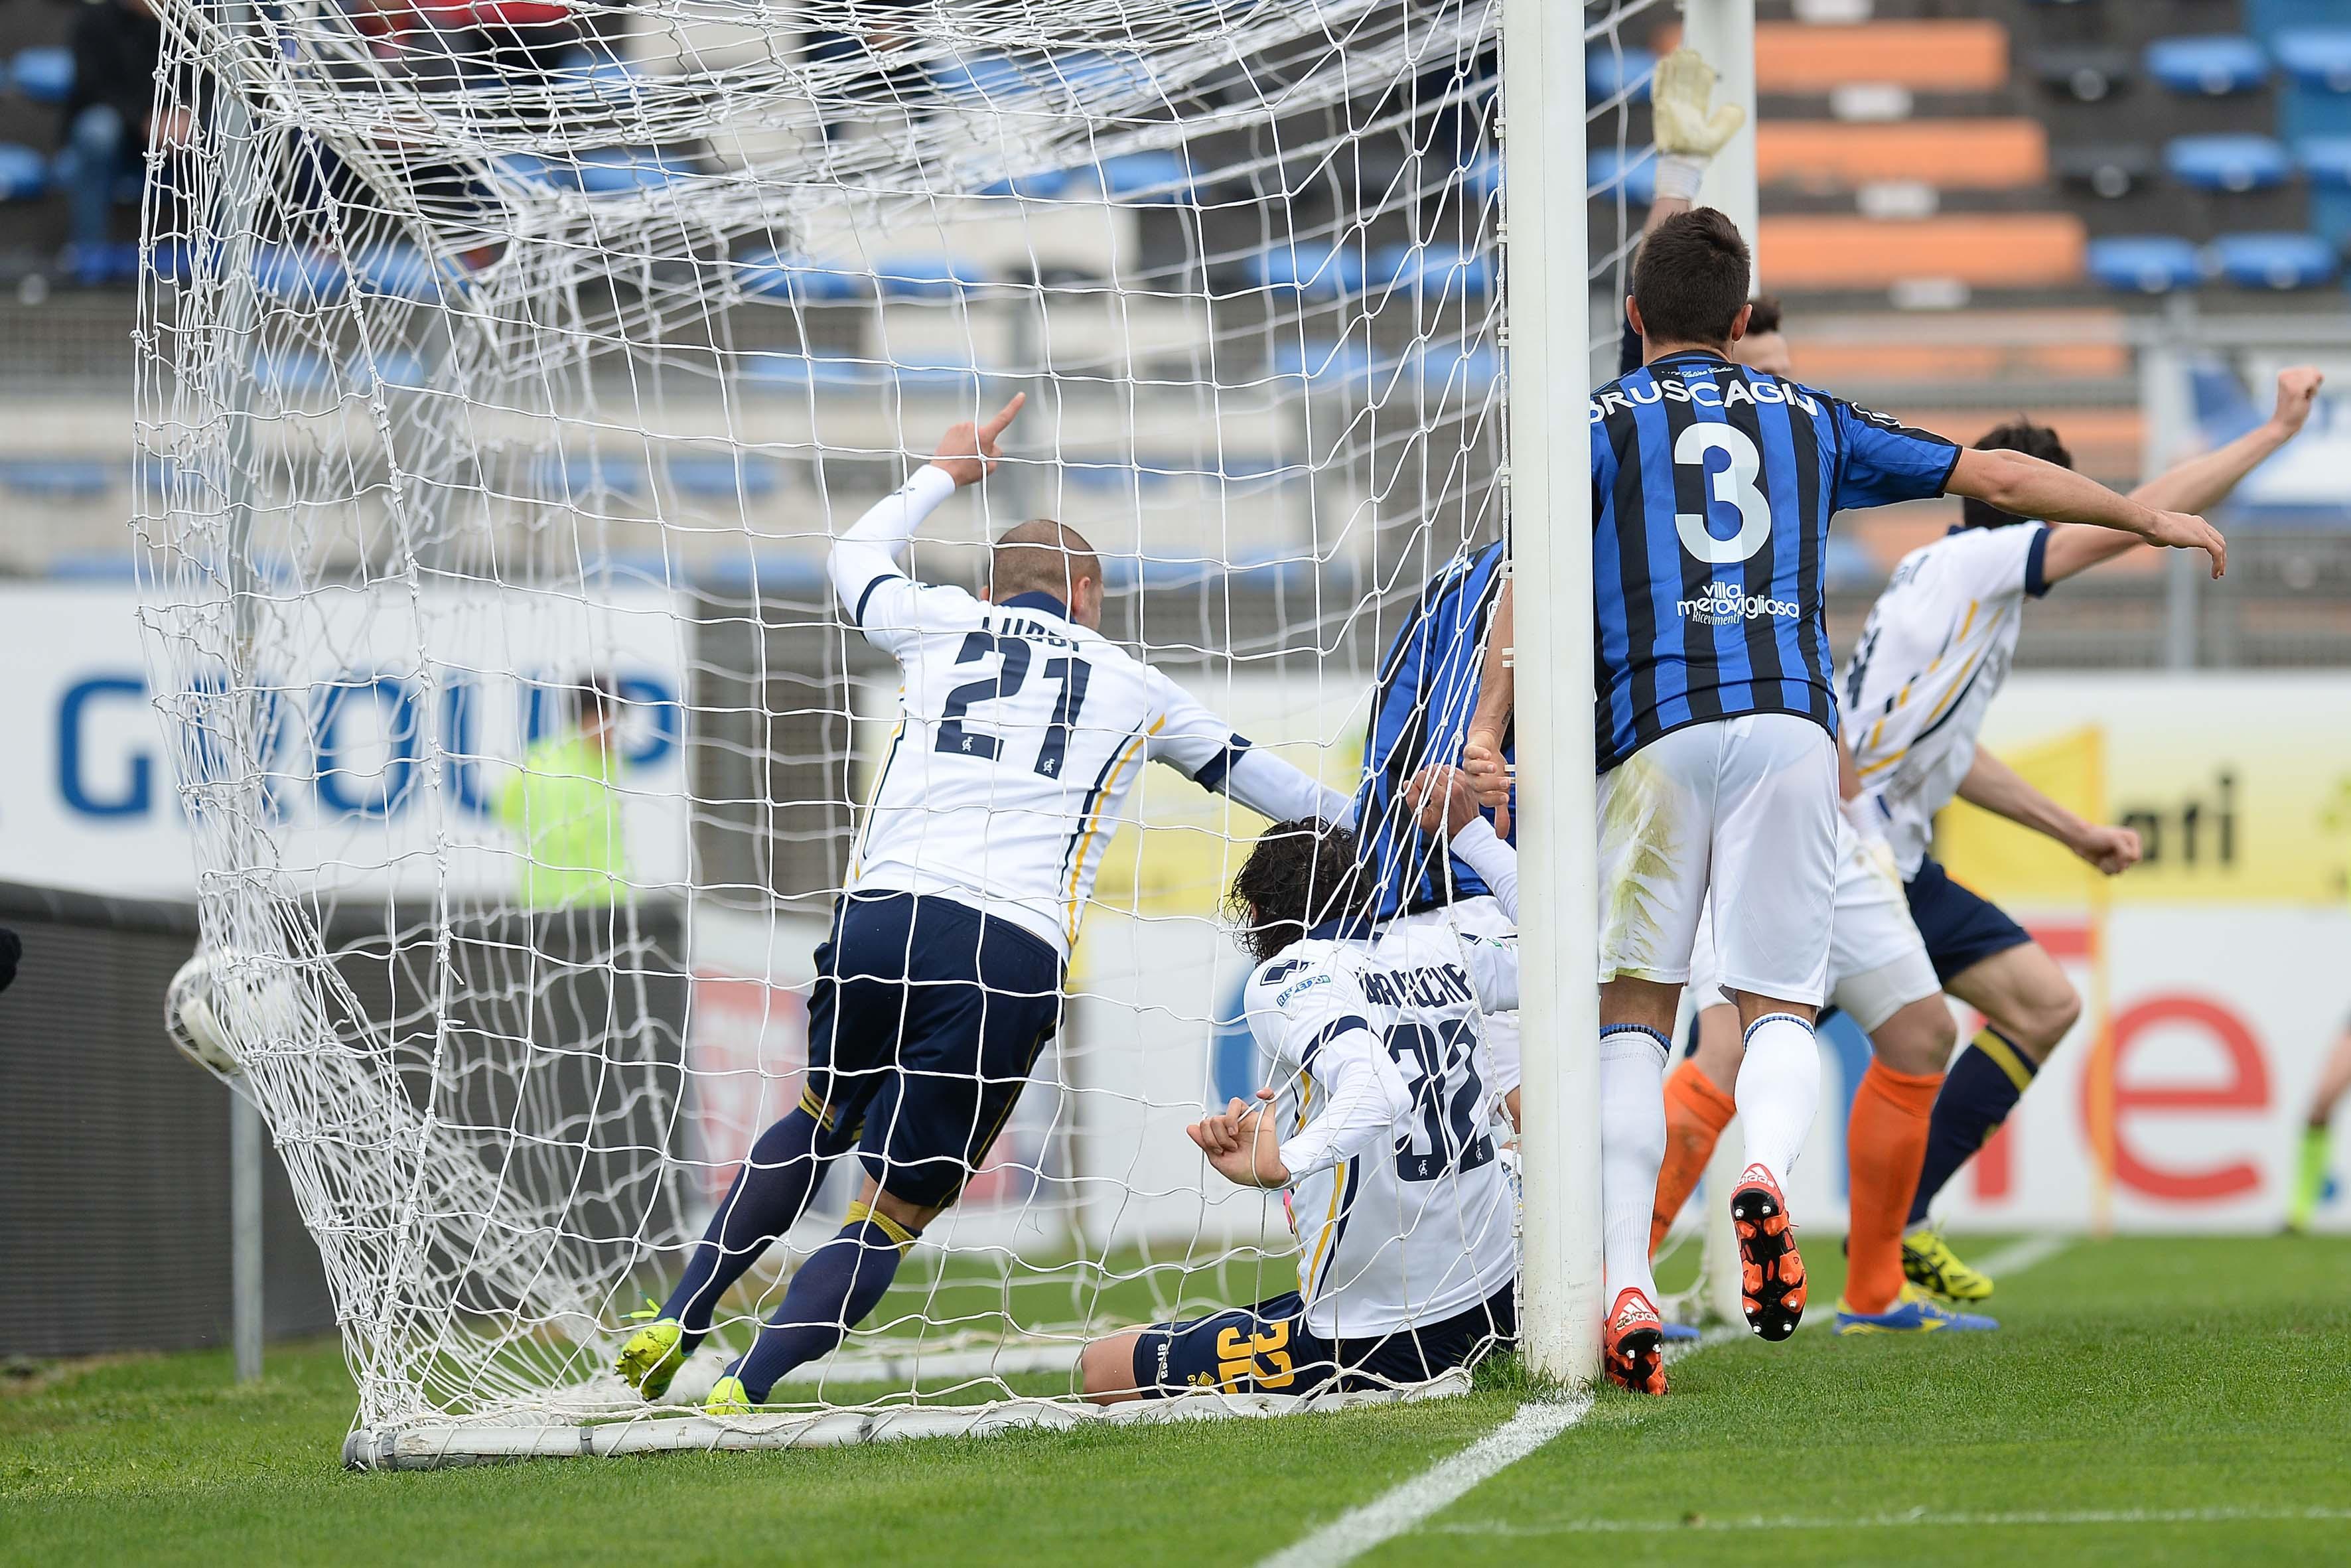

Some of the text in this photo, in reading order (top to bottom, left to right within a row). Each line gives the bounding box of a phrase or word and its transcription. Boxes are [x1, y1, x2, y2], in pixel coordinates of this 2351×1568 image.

[1675, 422, 1772, 563] 3
[1676, 595, 1801, 620] meravigliosa
[1692, 609, 1742, 626] Ricevimenti
[1701, 581, 1743, 599] villa
[935, 632, 1092, 780] 21
[1384, 1018, 1496, 1182] 32
[1217, 1320, 1295, 1393] 32
